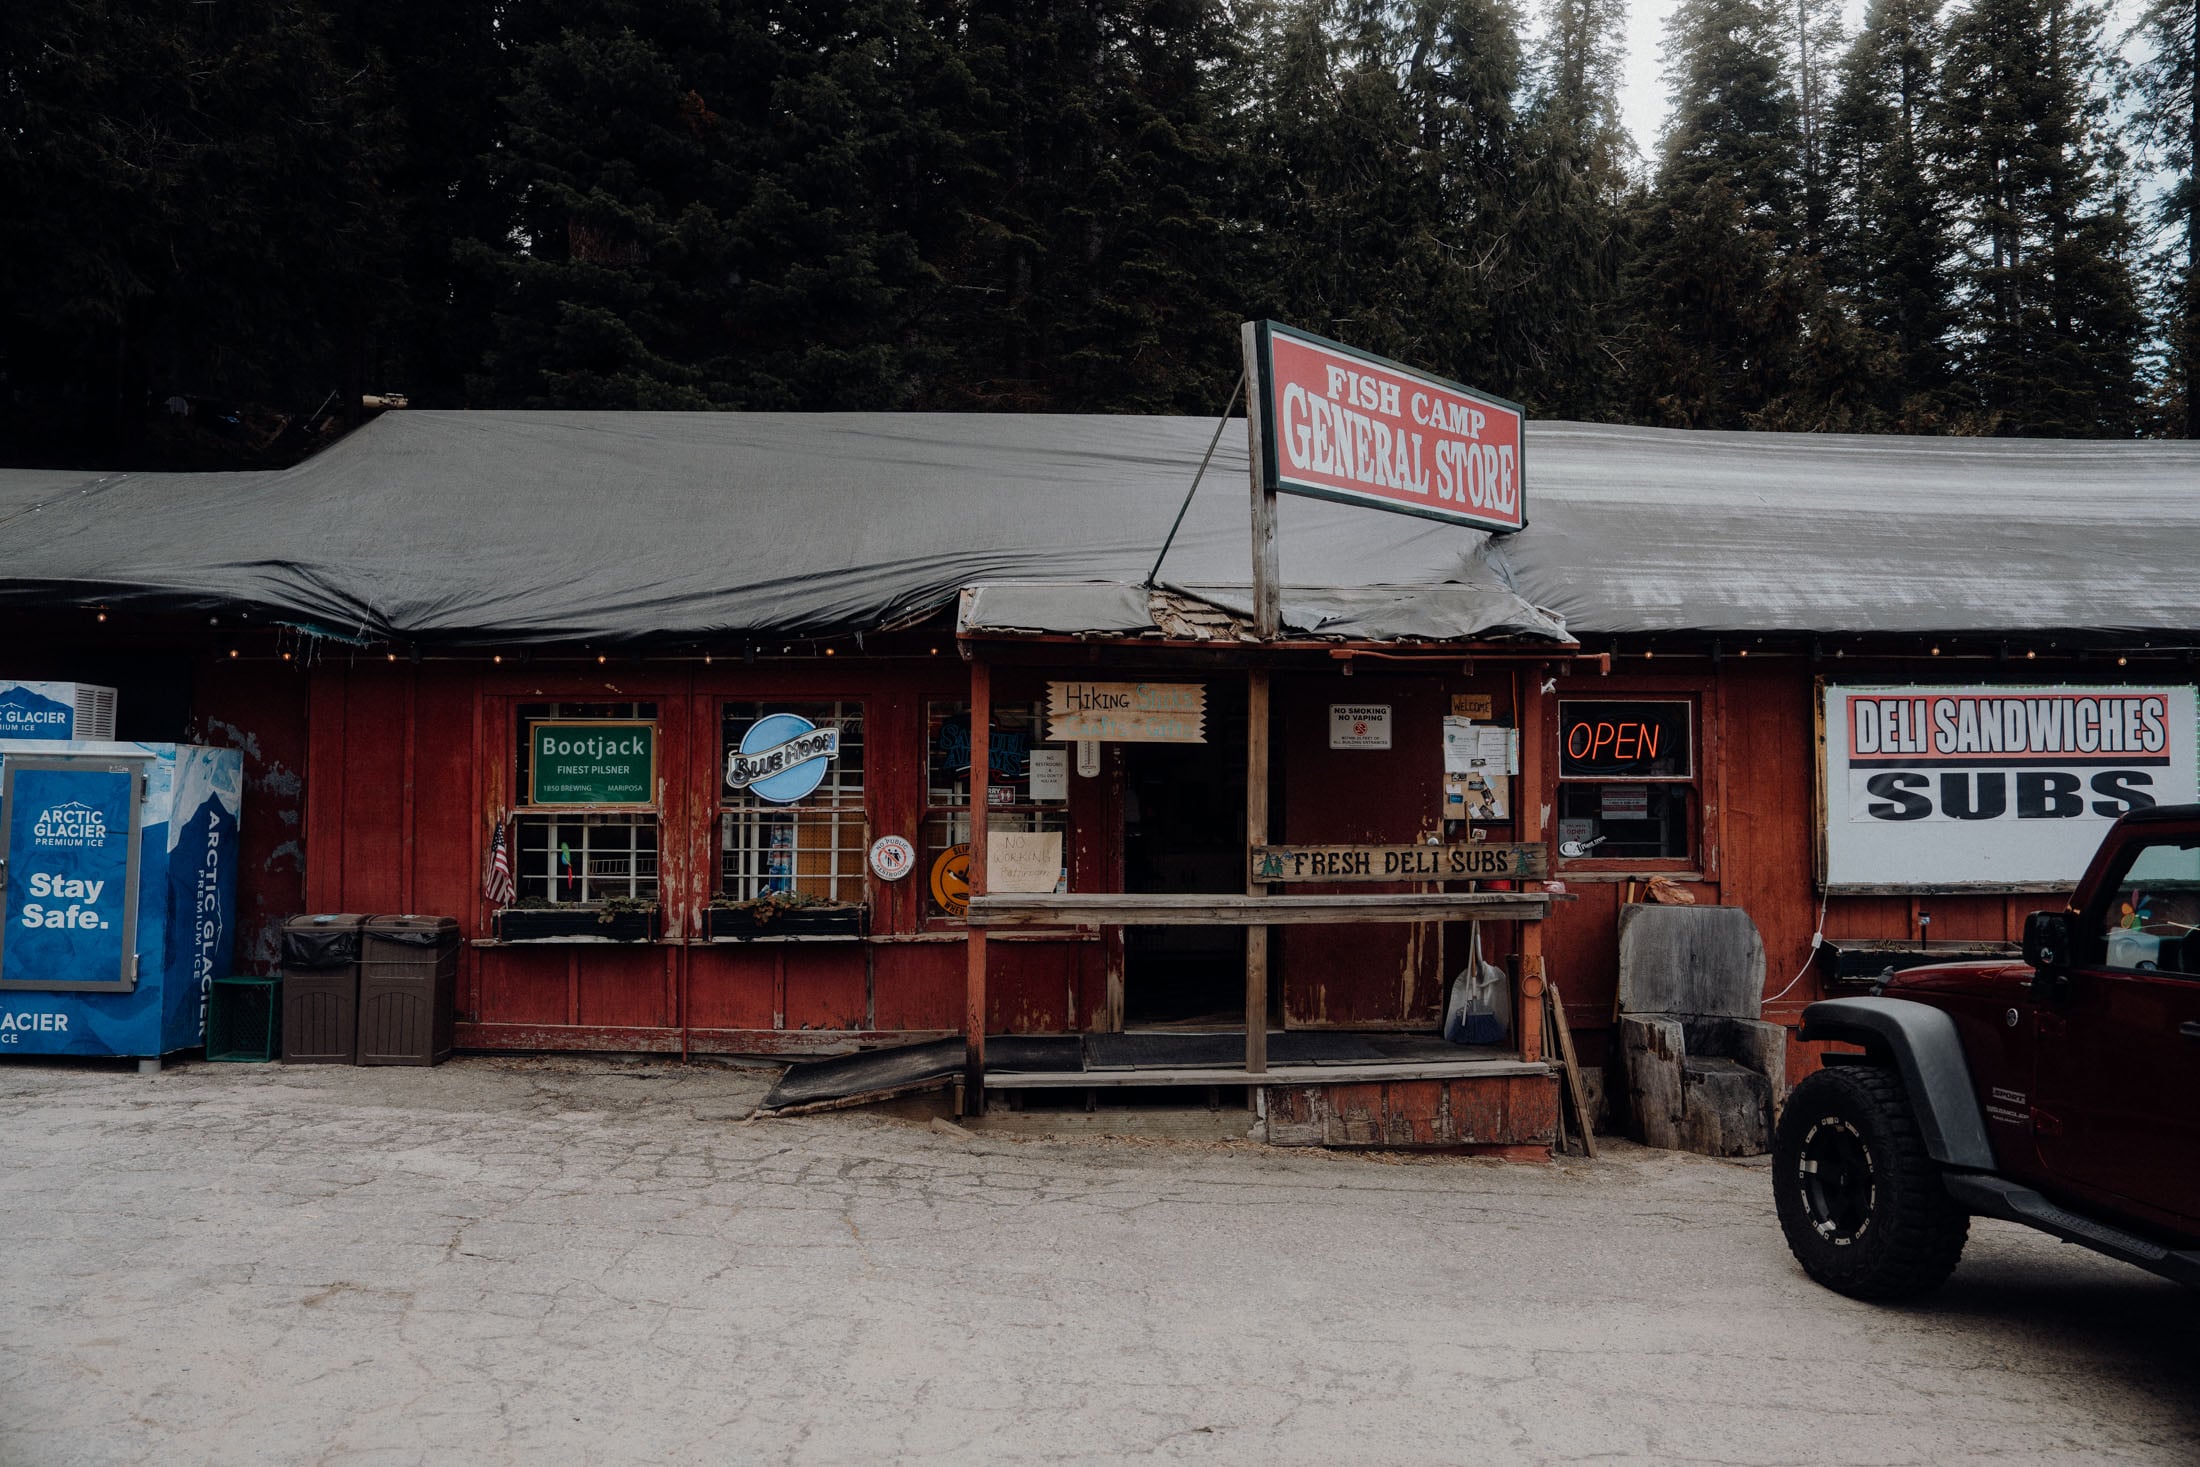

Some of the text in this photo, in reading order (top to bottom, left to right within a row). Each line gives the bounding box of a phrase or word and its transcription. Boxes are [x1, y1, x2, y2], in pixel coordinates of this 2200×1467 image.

[1326, 364, 1486, 439] FISH CAMP
[1283, 382, 1516, 515] GENERAL STORE
[1066, 684, 1130, 710] HIKING
[1453, 701, 1490, 713] WELCOME
[6, 711, 66, 724] GLACIER
[1854, 697, 2166, 754] DELI SANDWICHES
[543, 736, 645, 760] Bootjack
[1567, 721, 1660, 760] OPEN
[730, 732, 836, 784] BLUE MOON
[557, 765, 630, 774] FINEST PILSNER
[560, 784, 592, 792] BREWING
[607, 784, 643, 792] MARIPOSA
[1866, 770, 2157, 821] SUBS
[39, 809, 103, 824] ARCTIC
[33, 823, 107, 838] GLACIER
[35, 838, 104, 847] PREMIUM ICE
[885, 838, 908, 850] PUBLIC
[1005, 836, 1025, 848] NO
[204, 810, 221, 912] ARCTIC
[1294, 850, 1508, 875] FRESH DELI SUBS
[29, 872, 105, 904] Stay
[21, 903, 109, 930] Safe.
[944, 902, 965, 915] WHEN
[193, 869, 205, 979] PREMIUM ICE
[0, 1012, 68, 1031] ACIER
[1, 1033, 19, 1043] CE
[1995, 1089, 2025, 1102] SPORT
